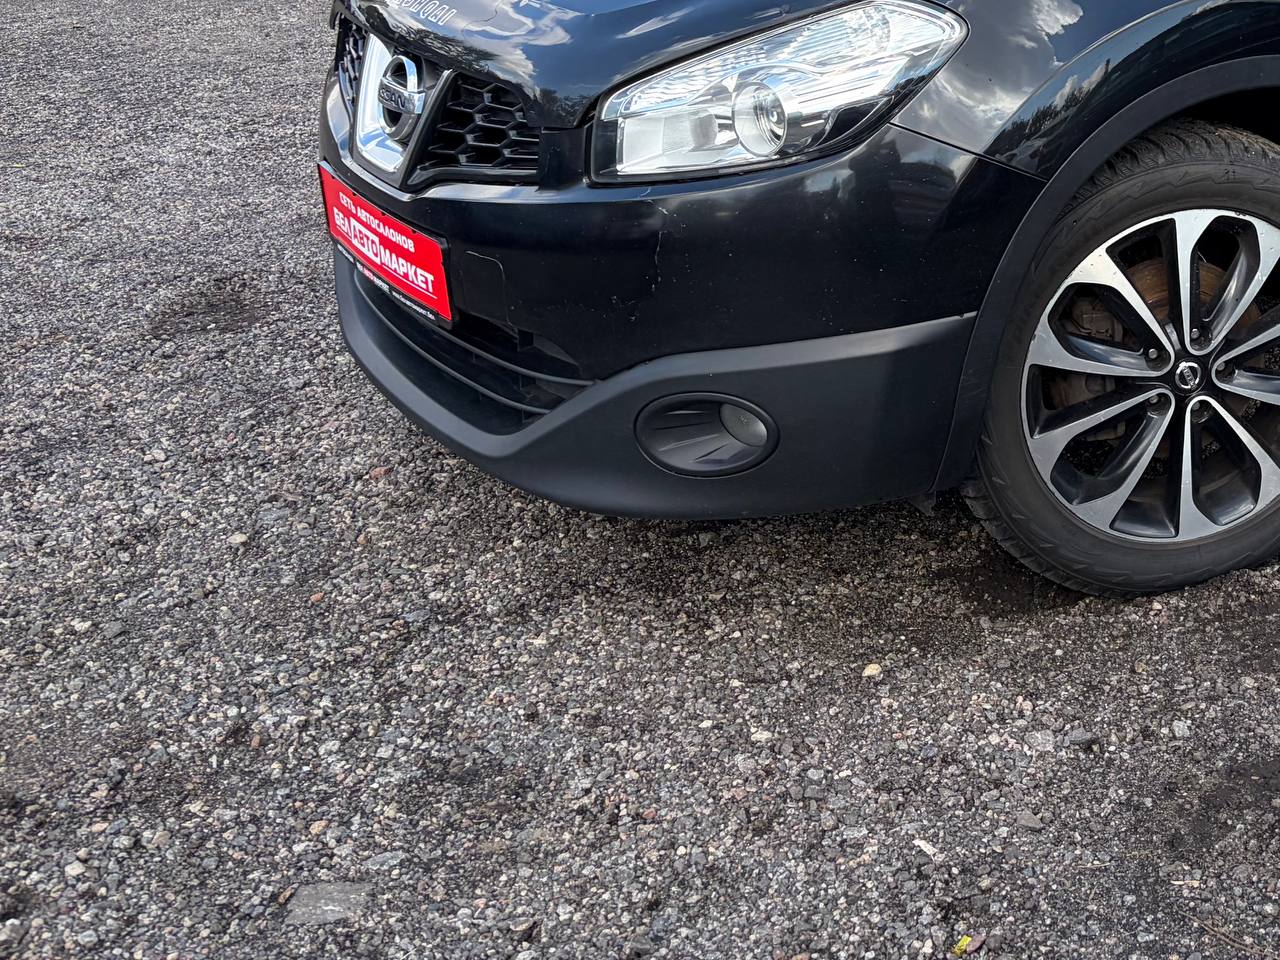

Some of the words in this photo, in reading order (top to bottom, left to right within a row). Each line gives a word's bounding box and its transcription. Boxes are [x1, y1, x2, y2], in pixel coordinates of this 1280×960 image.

[333, 206, 351, 237] БЕЛ
[351, 221, 379, 261] АВТО
[380, 245, 435, 293] МАРКЕТ
[339, 192, 356, 214] СЕТЬ
[357, 206, 415, 253] АВТОСАЛОНОВ
